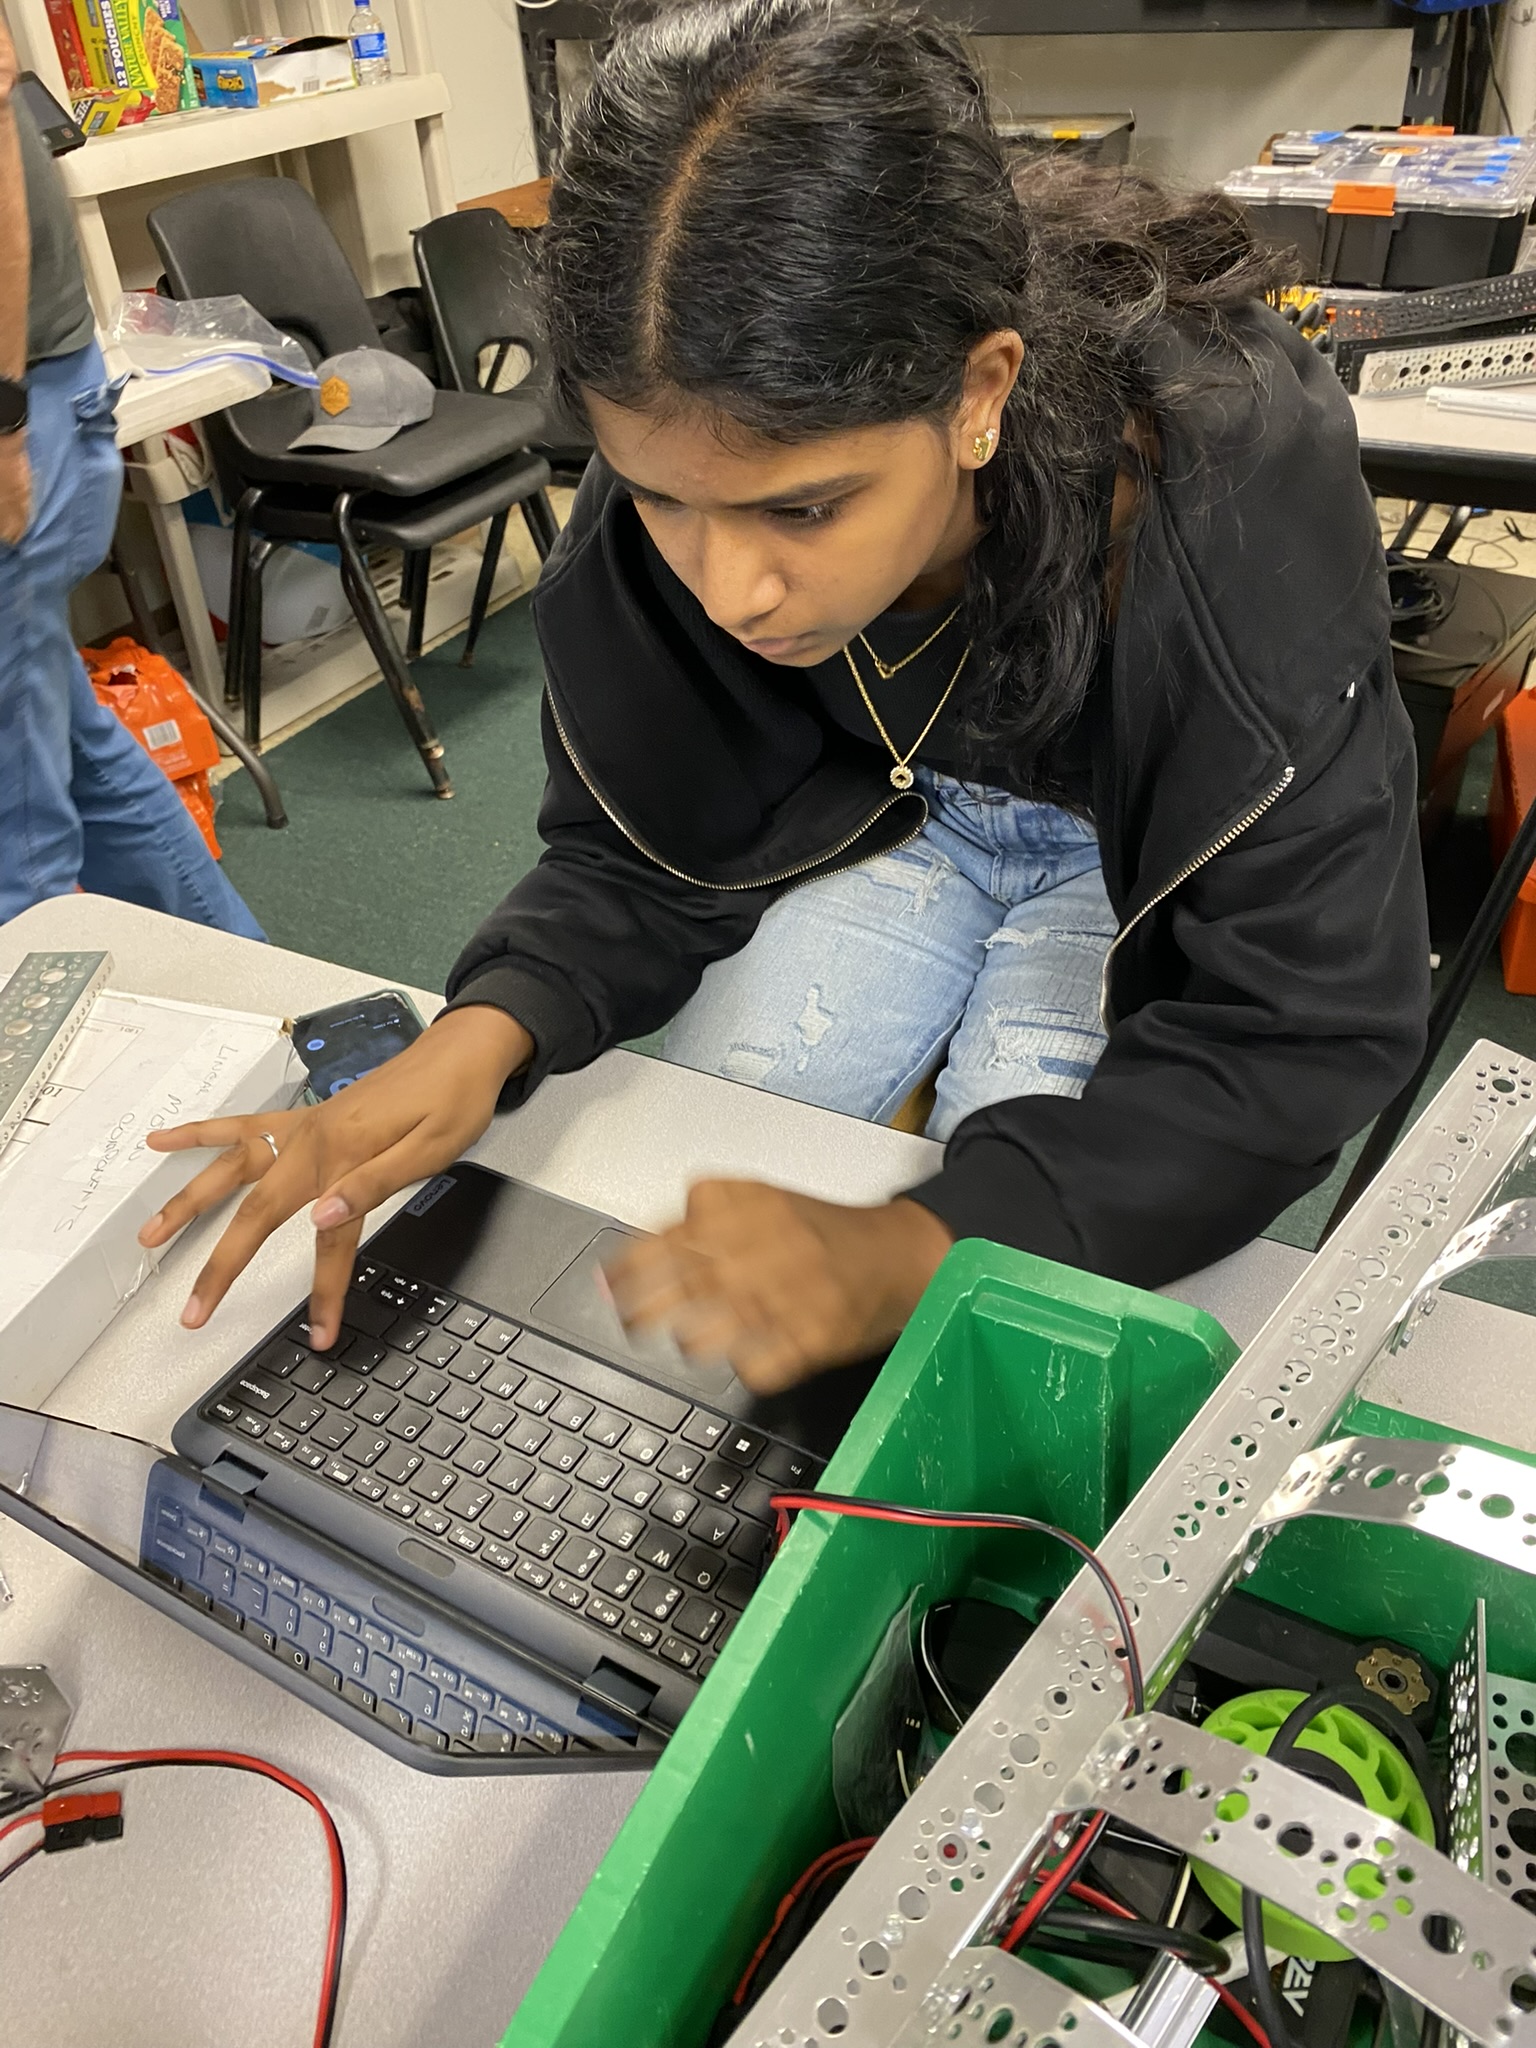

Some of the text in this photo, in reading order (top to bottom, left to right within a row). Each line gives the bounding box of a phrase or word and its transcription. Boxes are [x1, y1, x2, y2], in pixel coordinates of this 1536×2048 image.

[100, 0, 124, 68] POUCHES
[131, 15, 148, 68] CRUNCHY
[123, 42, 147, 88] NATURE
[116, 70, 128, 88] 12
[414, 1179, 450, 1211] Lenovo
[464, 1317, 478, 1328] Ctrl
[500, 1333, 511, 1342] Alt
[240, 1380, 270, 1400] Backspace
[498, 1382, 514, 1395] M
[428, 1390, 436, 1402] L
[216, 1404, 234, 1416] Delete
[534, 1399, 548, 1411] N
[372, 1411, 385, 1422] P
[456, 1406, 470, 1418] K
[491, 1423, 503, 1433] J
[570, 1416, 582, 1428] B
[404, 1425, 416, 1437] O
[603, 1432, 616, 1444] V
[374, 1440, 384, 1450] 0
[524, 1438, 538, 1451] H
[407, 1457, 418, 1468] 9
[472, 1460, 485, 1472] U
[560, 1454, 572, 1468] G
[676, 1465, 692, 1479] X
[790, 1464, 802, 1476] Fn
[442, 1474, 452, 1485] 8
[506, 1478, 518, 1490] Y
[596, 1474, 610, 1486] F
[715, 1484, 731, 1498] Z
[476, 1493, 488, 1504] 7
[543, 1495, 556, 1508] T
[634, 1491, 648, 1504] D
[512, 1510, 524, 1522] 6
[580, 1512, 595, 1527] R
[672, 1510, 686, 1523] S
[550, 1530, 561, 1541] 5
[618, 1532, 633, 1546] E
[712, 1528, 726, 1542] A
[586, 1548, 598, 1560] 4
[652, 1550, 670, 1566] W
[626, 1568, 638, 1581] 3
[698, 1571, 710, 1585] Q
[666, 1588, 678, 1602] 2
[708, 1610, 718, 1624] 1
